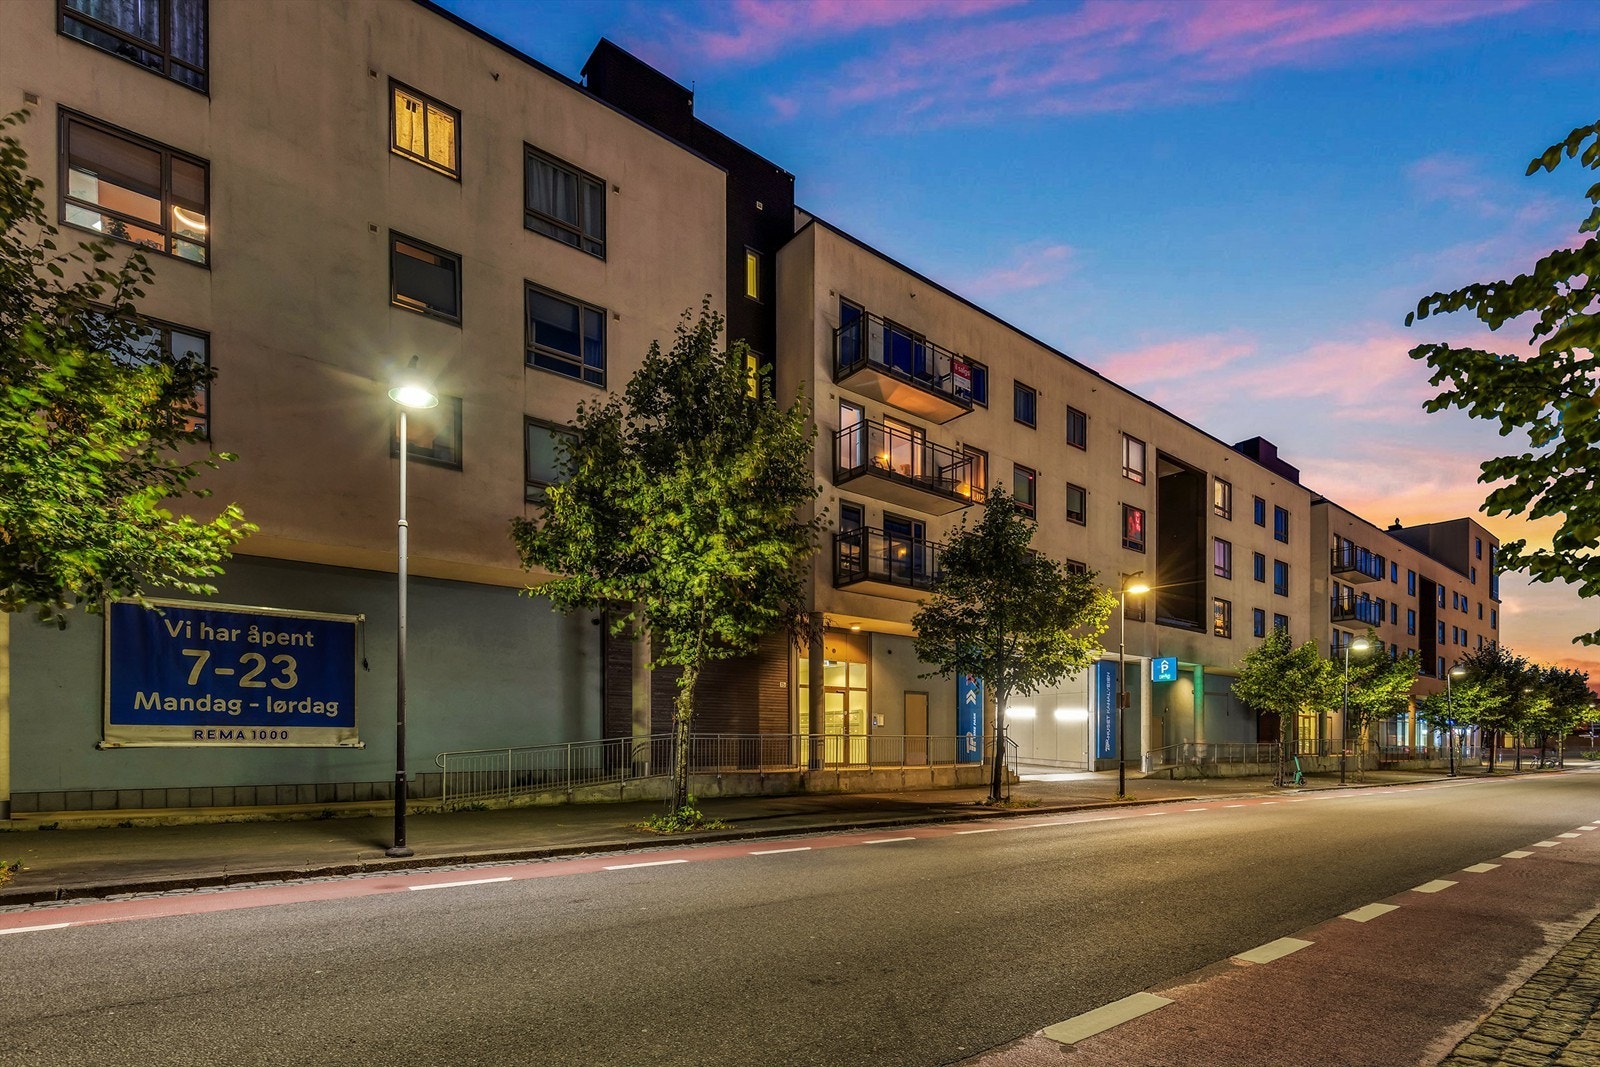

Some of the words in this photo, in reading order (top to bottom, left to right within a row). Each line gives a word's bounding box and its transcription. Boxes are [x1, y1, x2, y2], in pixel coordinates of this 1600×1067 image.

[164, 618, 192, 639] Vi
[200, 621, 241, 642] har
[247, 625, 315, 647] åpent
[182, 649, 298, 690] 7-23
[1161, 664, 1169, 674] P
[134, 691, 242, 715] Mandag
[266, 695, 339, 717] lørdag
[193, 729, 246, 740] REMA
[252, 730, 289, 740] 1000
